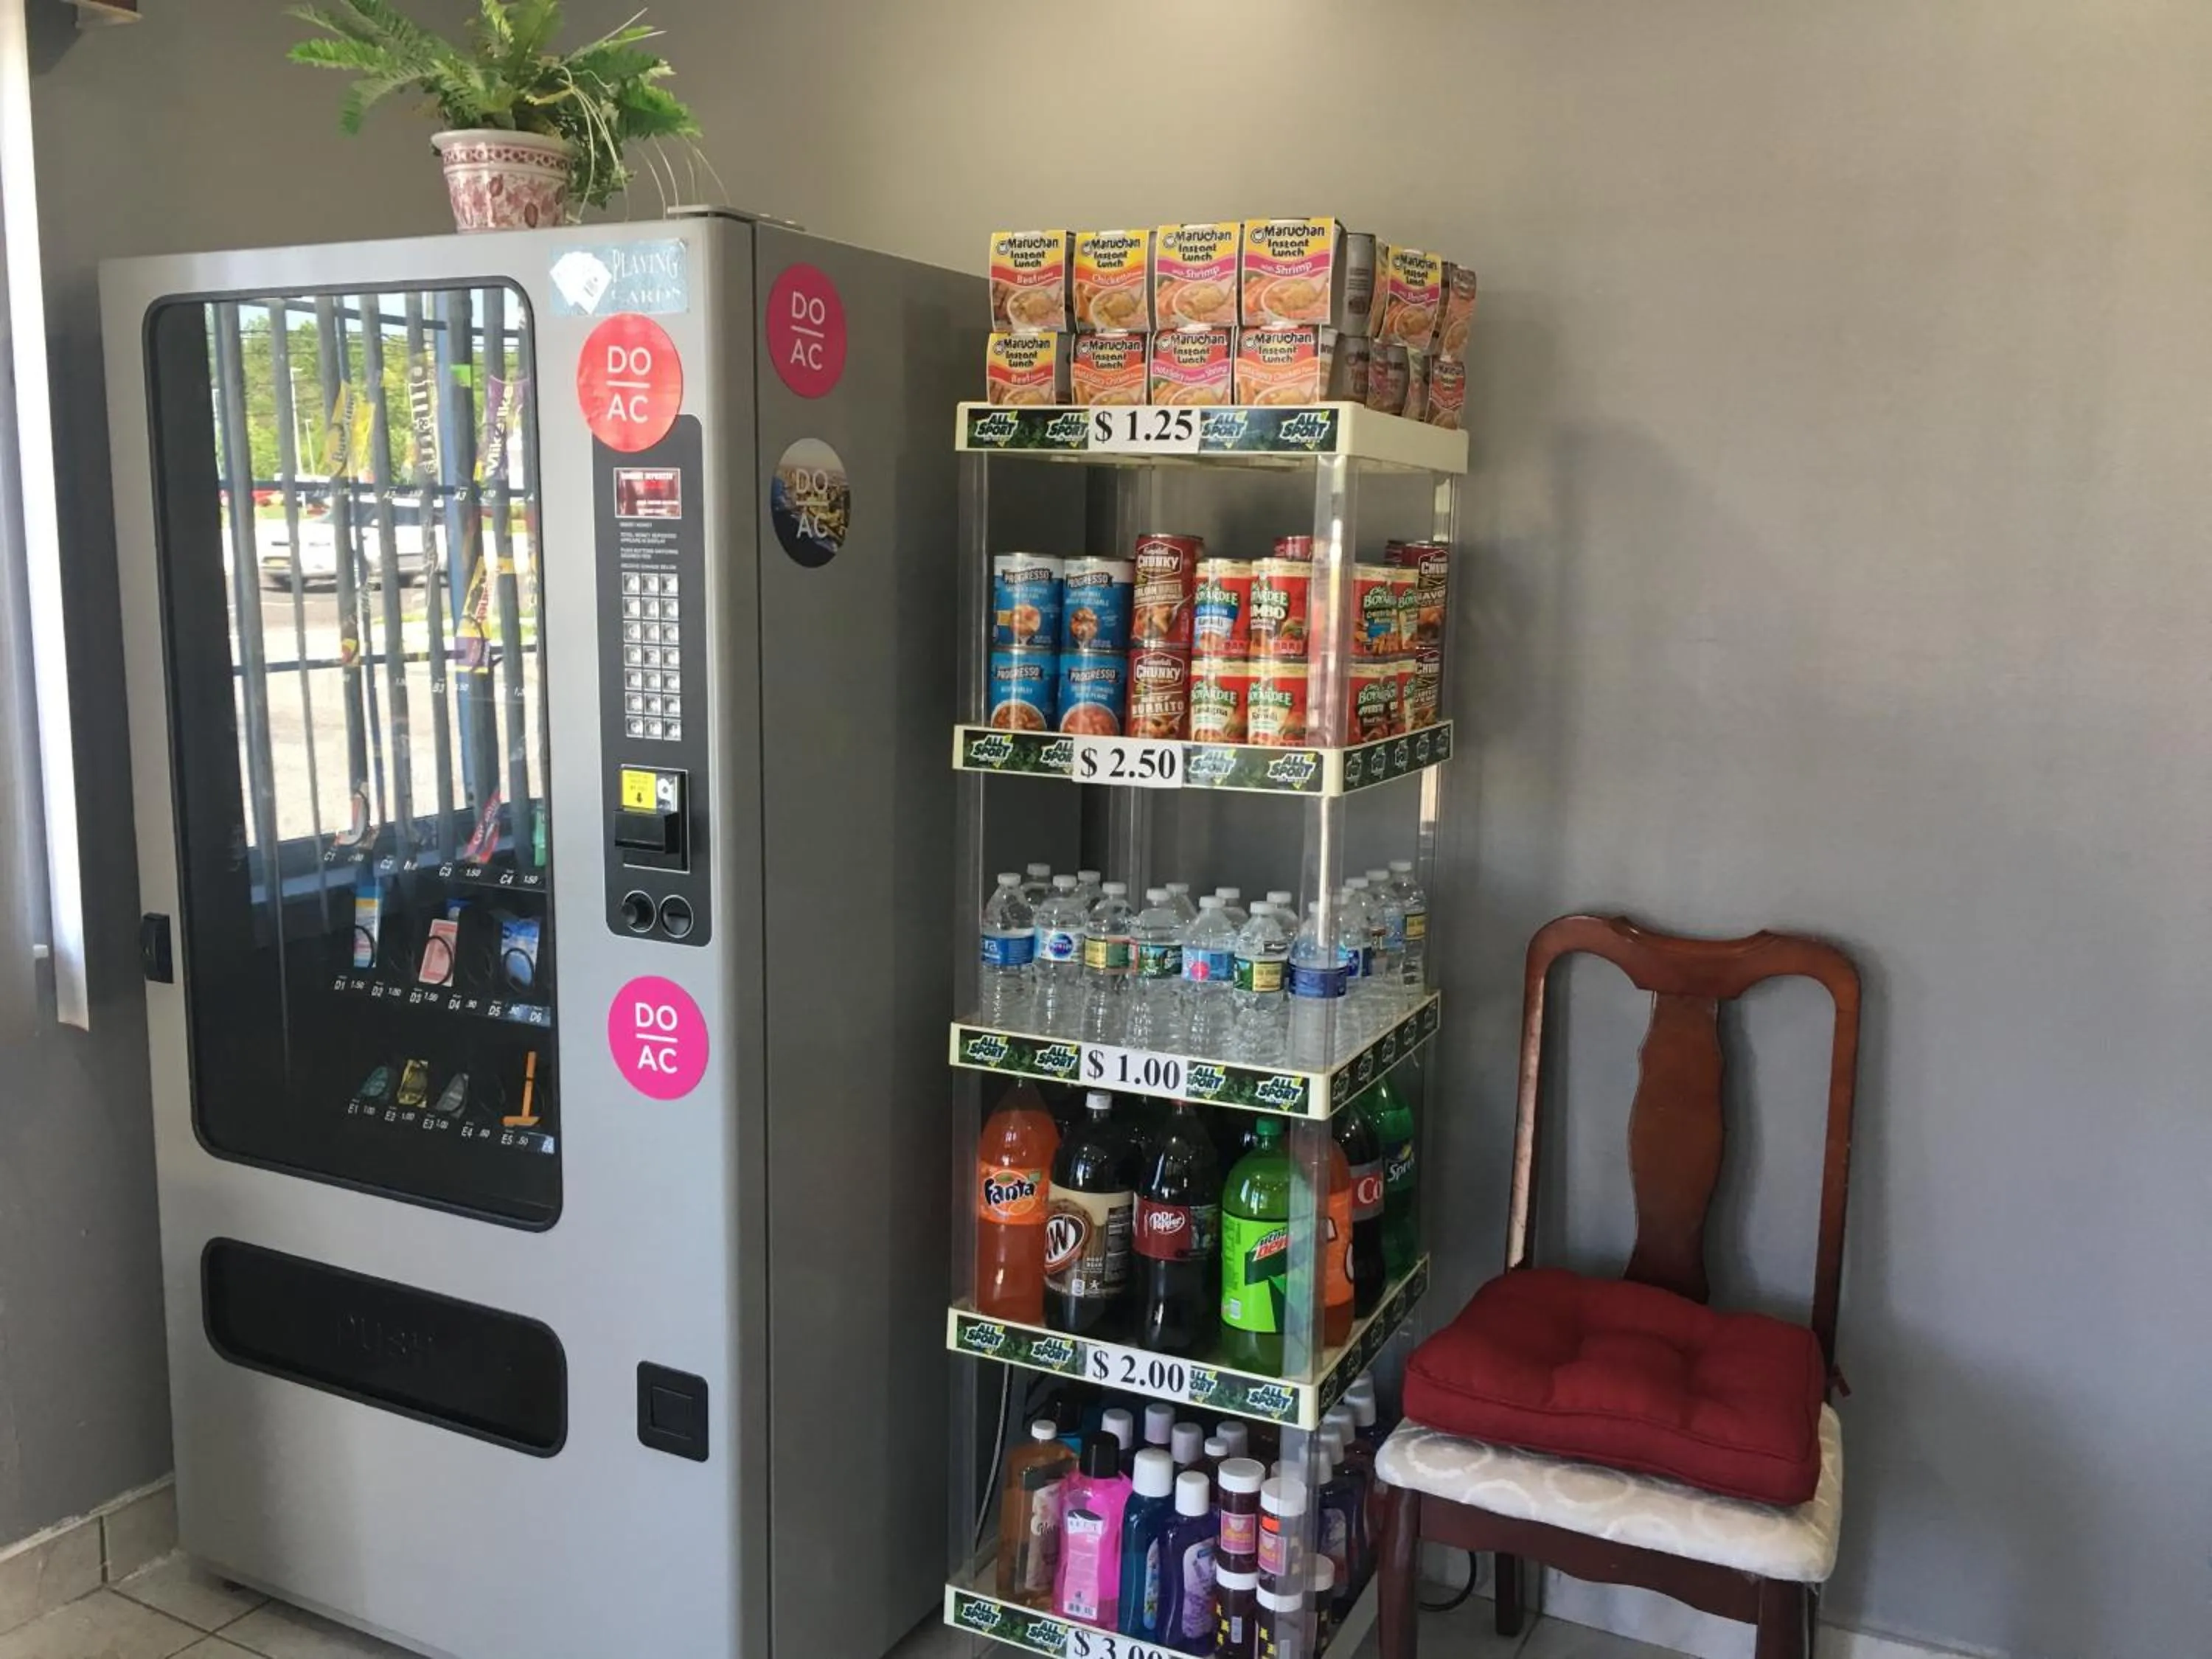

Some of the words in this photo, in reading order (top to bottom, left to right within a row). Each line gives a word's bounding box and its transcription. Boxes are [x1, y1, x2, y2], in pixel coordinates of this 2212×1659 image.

[1175, 231, 1231, 241] Maruchan
[1265, 225, 1326, 237] Maruchan
[1008, 238, 1059, 249] Maruchan
[1091, 238, 1140, 249] Maruchan
[1179, 243, 1217, 253] Instant
[1267, 239, 1310, 248] Instant
[1093, 251, 1127, 259] Instant
[1182, 253, 1212, 262] Lunch
[1272, 248, 1304, 257] Lunch
[611, 248, 680, 283] PLAYING
[1014, 259, 1041, 268] Lunch
[1097, 260, 1124, 268] Lunch
[1275, 261, 1312, 275] Shrimp
[1186, 265, 1219, 279] Shrimp
[791, 291, 825, 326] DO
[1004, 339, 1050, 349] Maruchan
[1089, 340, 1140, 350] Maruchan
[1172, 334, 1226, 344] Maruchan
[1256, 333, 1312, 344] Maruchan
[790, 338, 823, 371] AC
[1006, 351, 1037, 359] Instant
[1092, 353, 1126, 361] Instant
[1259, 346, 1297, 355] Instant
[607, 346, 652, 375] DO
[1008, 359, 1034, 367] Lunch
[1262, 355, 1292, 364] Lunch
[607, 394, 649, 423] AC
[990, 414, 1007, 425] ALL
[1062, 414, 1080, 425] ALL
[1214, 414, 1234, 424] ALL
[1296, 413, 1319, 425] ALL
[978, 421, 1017, 436] SPORT
[1048, 422, 1088, 437] SPORT
[1095, 410, 1113, 443] $
[1126, 409, 1192, 441] 1.25
[1203, 422, 1245, 436] SPORT
[1282, 421, 1329, 437] SPORT
[796, 469, 828, 493] DO
[797, 514, 828, 538] AC
[1138, 554, 1180, 570] CHUNKY
[1004, 570, 1049, 584] PROGRESSO
[1069, 574, 1109, 588] PROGRESSO
[1251, 603, 1286, 620] MBO
[996, 666, 1040, 679] PROGRESSO
[1070, 669, 1116, 682] PROGRESSO
[1137, 665, 1181, 681] CHUNKY
[984, 736, 1004, 746] ALL
[973, 744, 1010, 758] SPORT
[1043, 750, 1073, 763] SPOR
[1204, 751, 1224, 761] ALL
[1080, 747, 1097, 778] $
[1109, 747, 1175, 779] 2.50
[1192, 758, 1234, 773] SPORT
[1283, 754, 1304, 766] ALL
[1270, 762, 1314, 778] SPORT
[439, 866, 452, 877] C3
[635, 1003, 678, 1031] DO
[981, 1036, 998, 1047] ALL
[970, 1044, 1006, 1057] SPORT
[1048, 1046, 1068, 1057] ALL
[637, 1045, 678, 1074] AC
[1037, 1053, 1075, 1067] SPORT
[1087, 1049, 1104, 1080] $
[1117, 1054, 1180, 1090] 1.00
[1194, 1066, 1214, 1077] ALL
[1270, 1077, 1291, 1088] ALL
[1258, 1084, 1301, 1099] SPORT
[1152, 1213, 1182, 1232] Pepper
[978, 1324, 995, 1335] ALL
[967, 1332, 1004, 1346] SPORT
[1044, 1338, 1063, 1349] ALL
[1033, 1346, 1071, 1360] SPORT
[1093, 1350, 1109, 1380] $
[1121, 1354, 1185, 1392] 2.00
[1190, 1380, 1216, 1393] ORT
[1262, 1385, 1282, 1397] ALL
[1249, 1391, 1292, 1409] SPORT
[973, 1602, 993, 1613] ALL
[964, 1608, 999, 1623] SPORT
[1040, 1621, 1060, 1633] ALL
[1029, 1629, 1066, 1645] SPORT
[1074, 1630, 1091, 1658] $
